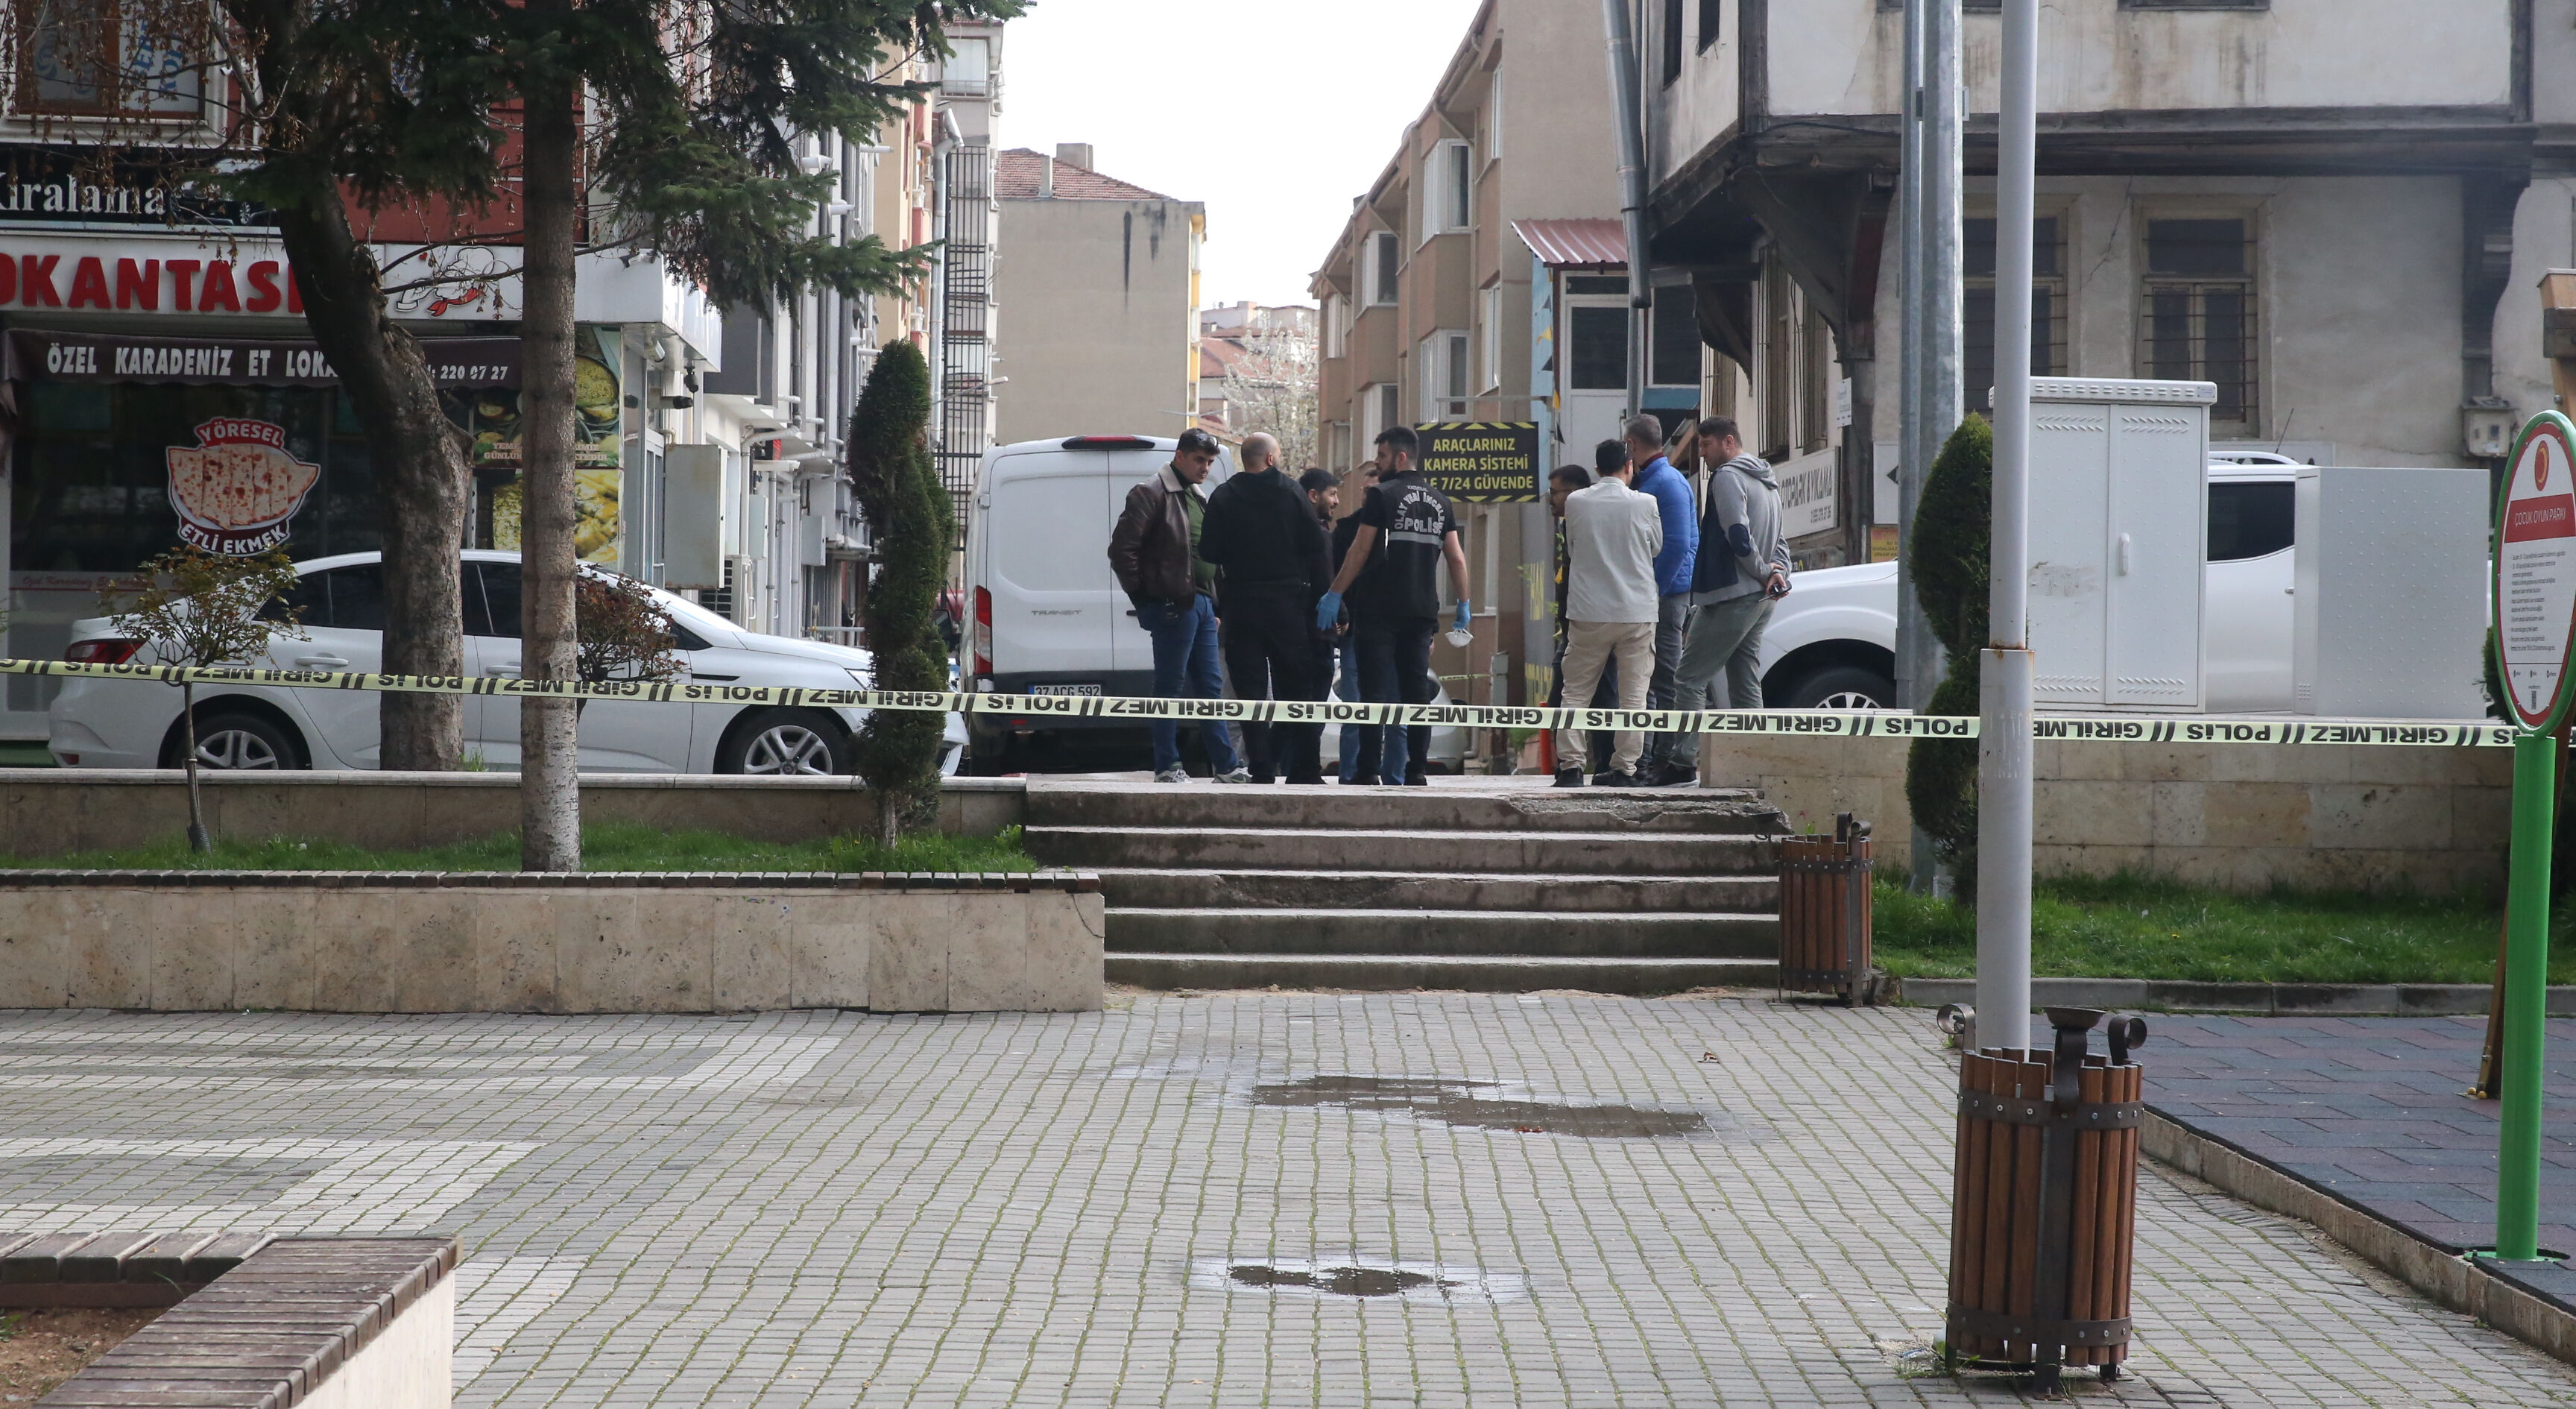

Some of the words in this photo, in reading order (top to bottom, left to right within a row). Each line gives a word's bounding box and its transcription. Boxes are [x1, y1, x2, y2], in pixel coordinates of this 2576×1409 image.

[46, 342, 97, 373] ÖZEL
[115, 345, 233, 376] KARADENİZ
[247, 350, 271, 376] ET
[440, 365, 466, 379] 220
[490, 365, 508, 380] 27
[199, 421, 280, 446] YÖRESEL
[1433, 438, 1515, 454] ARAÇLARINIZ
[1424, 458, 1477, 471] KAMERA
[1480, 453, 1529, 470] SİSTEMİ
[1441, 476, 1471, 490] 7/24
[1474, 473, 1533, 490] GÜVENDE
[2534, 509, 2549, 523] OYUN
[1404, 517, 1442, 535] POLİS
[180, 523, 219, 552] ETLİ
[223, 524, 288, 555] EKMEK
[1078, 686, 1100, 696] 592
